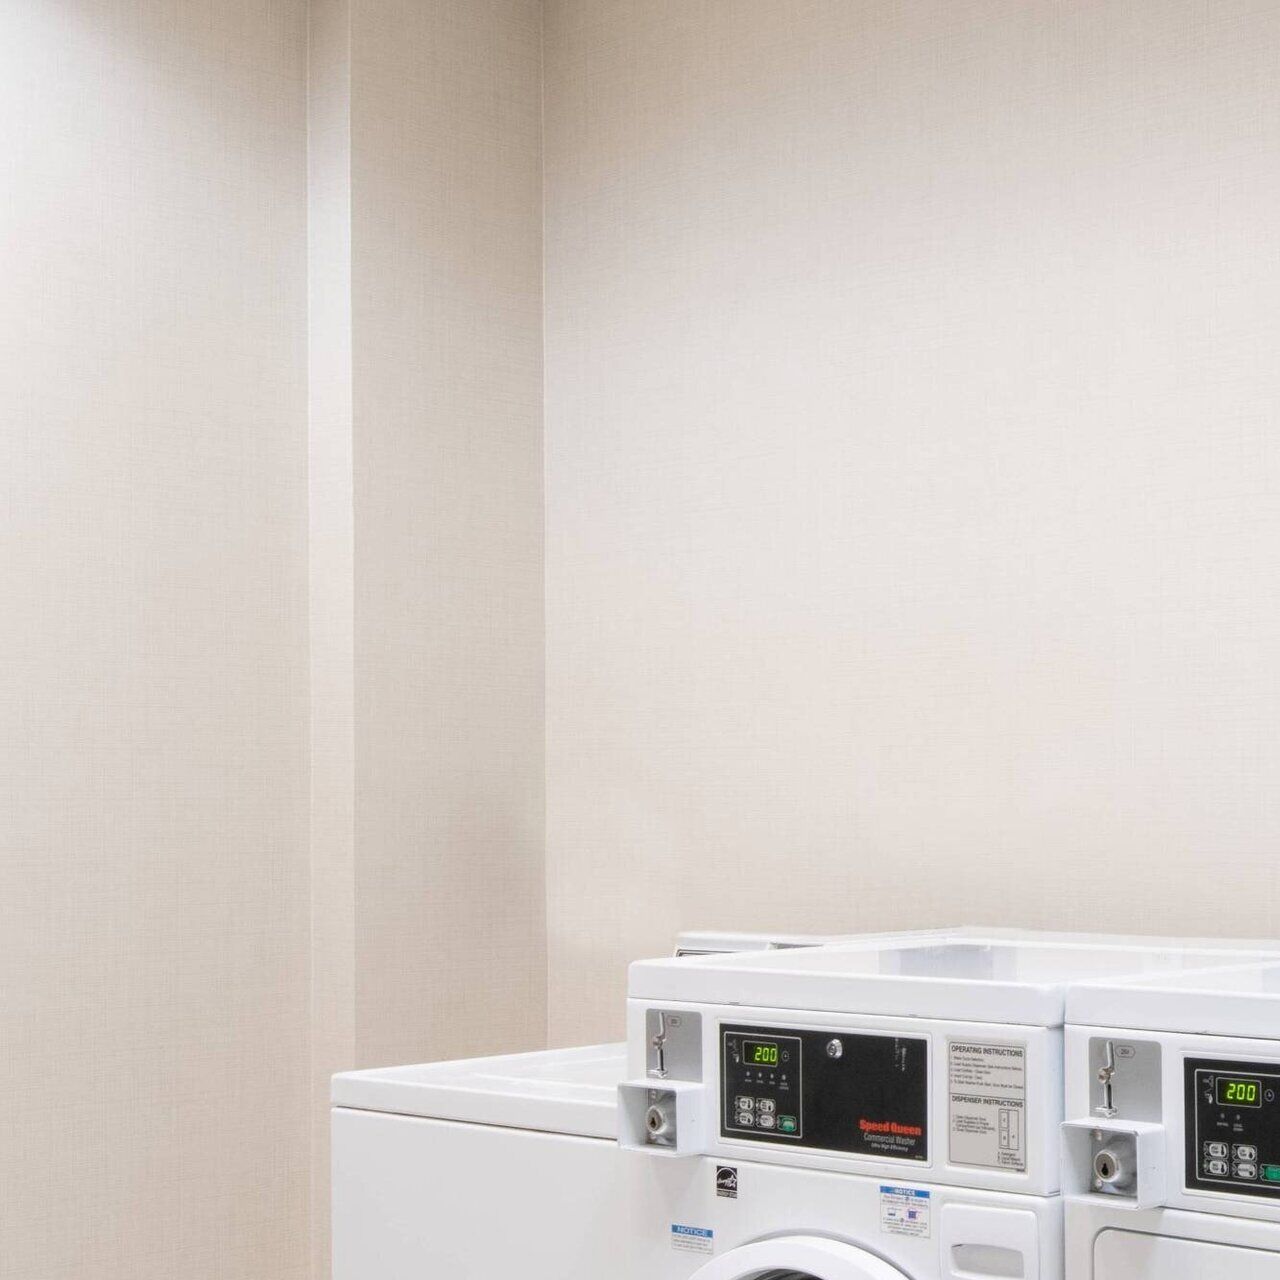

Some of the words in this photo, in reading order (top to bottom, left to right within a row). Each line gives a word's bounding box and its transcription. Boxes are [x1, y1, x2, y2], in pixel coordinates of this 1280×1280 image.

[754, 1046, 777, 1063] 200
[951, 1045, 982, 1055] OPERATING
[983, 1047, 1023, 1058] INSTRUCTIONS
[1226, 1083, 1256, 1101] 200
[859, 1119, 890, 1132] Speed
[890, 1122, 922, 1136] Queen
[863, 1132, 895, 1144] Commercial
[895, 1136, 916, 1146] Washer
